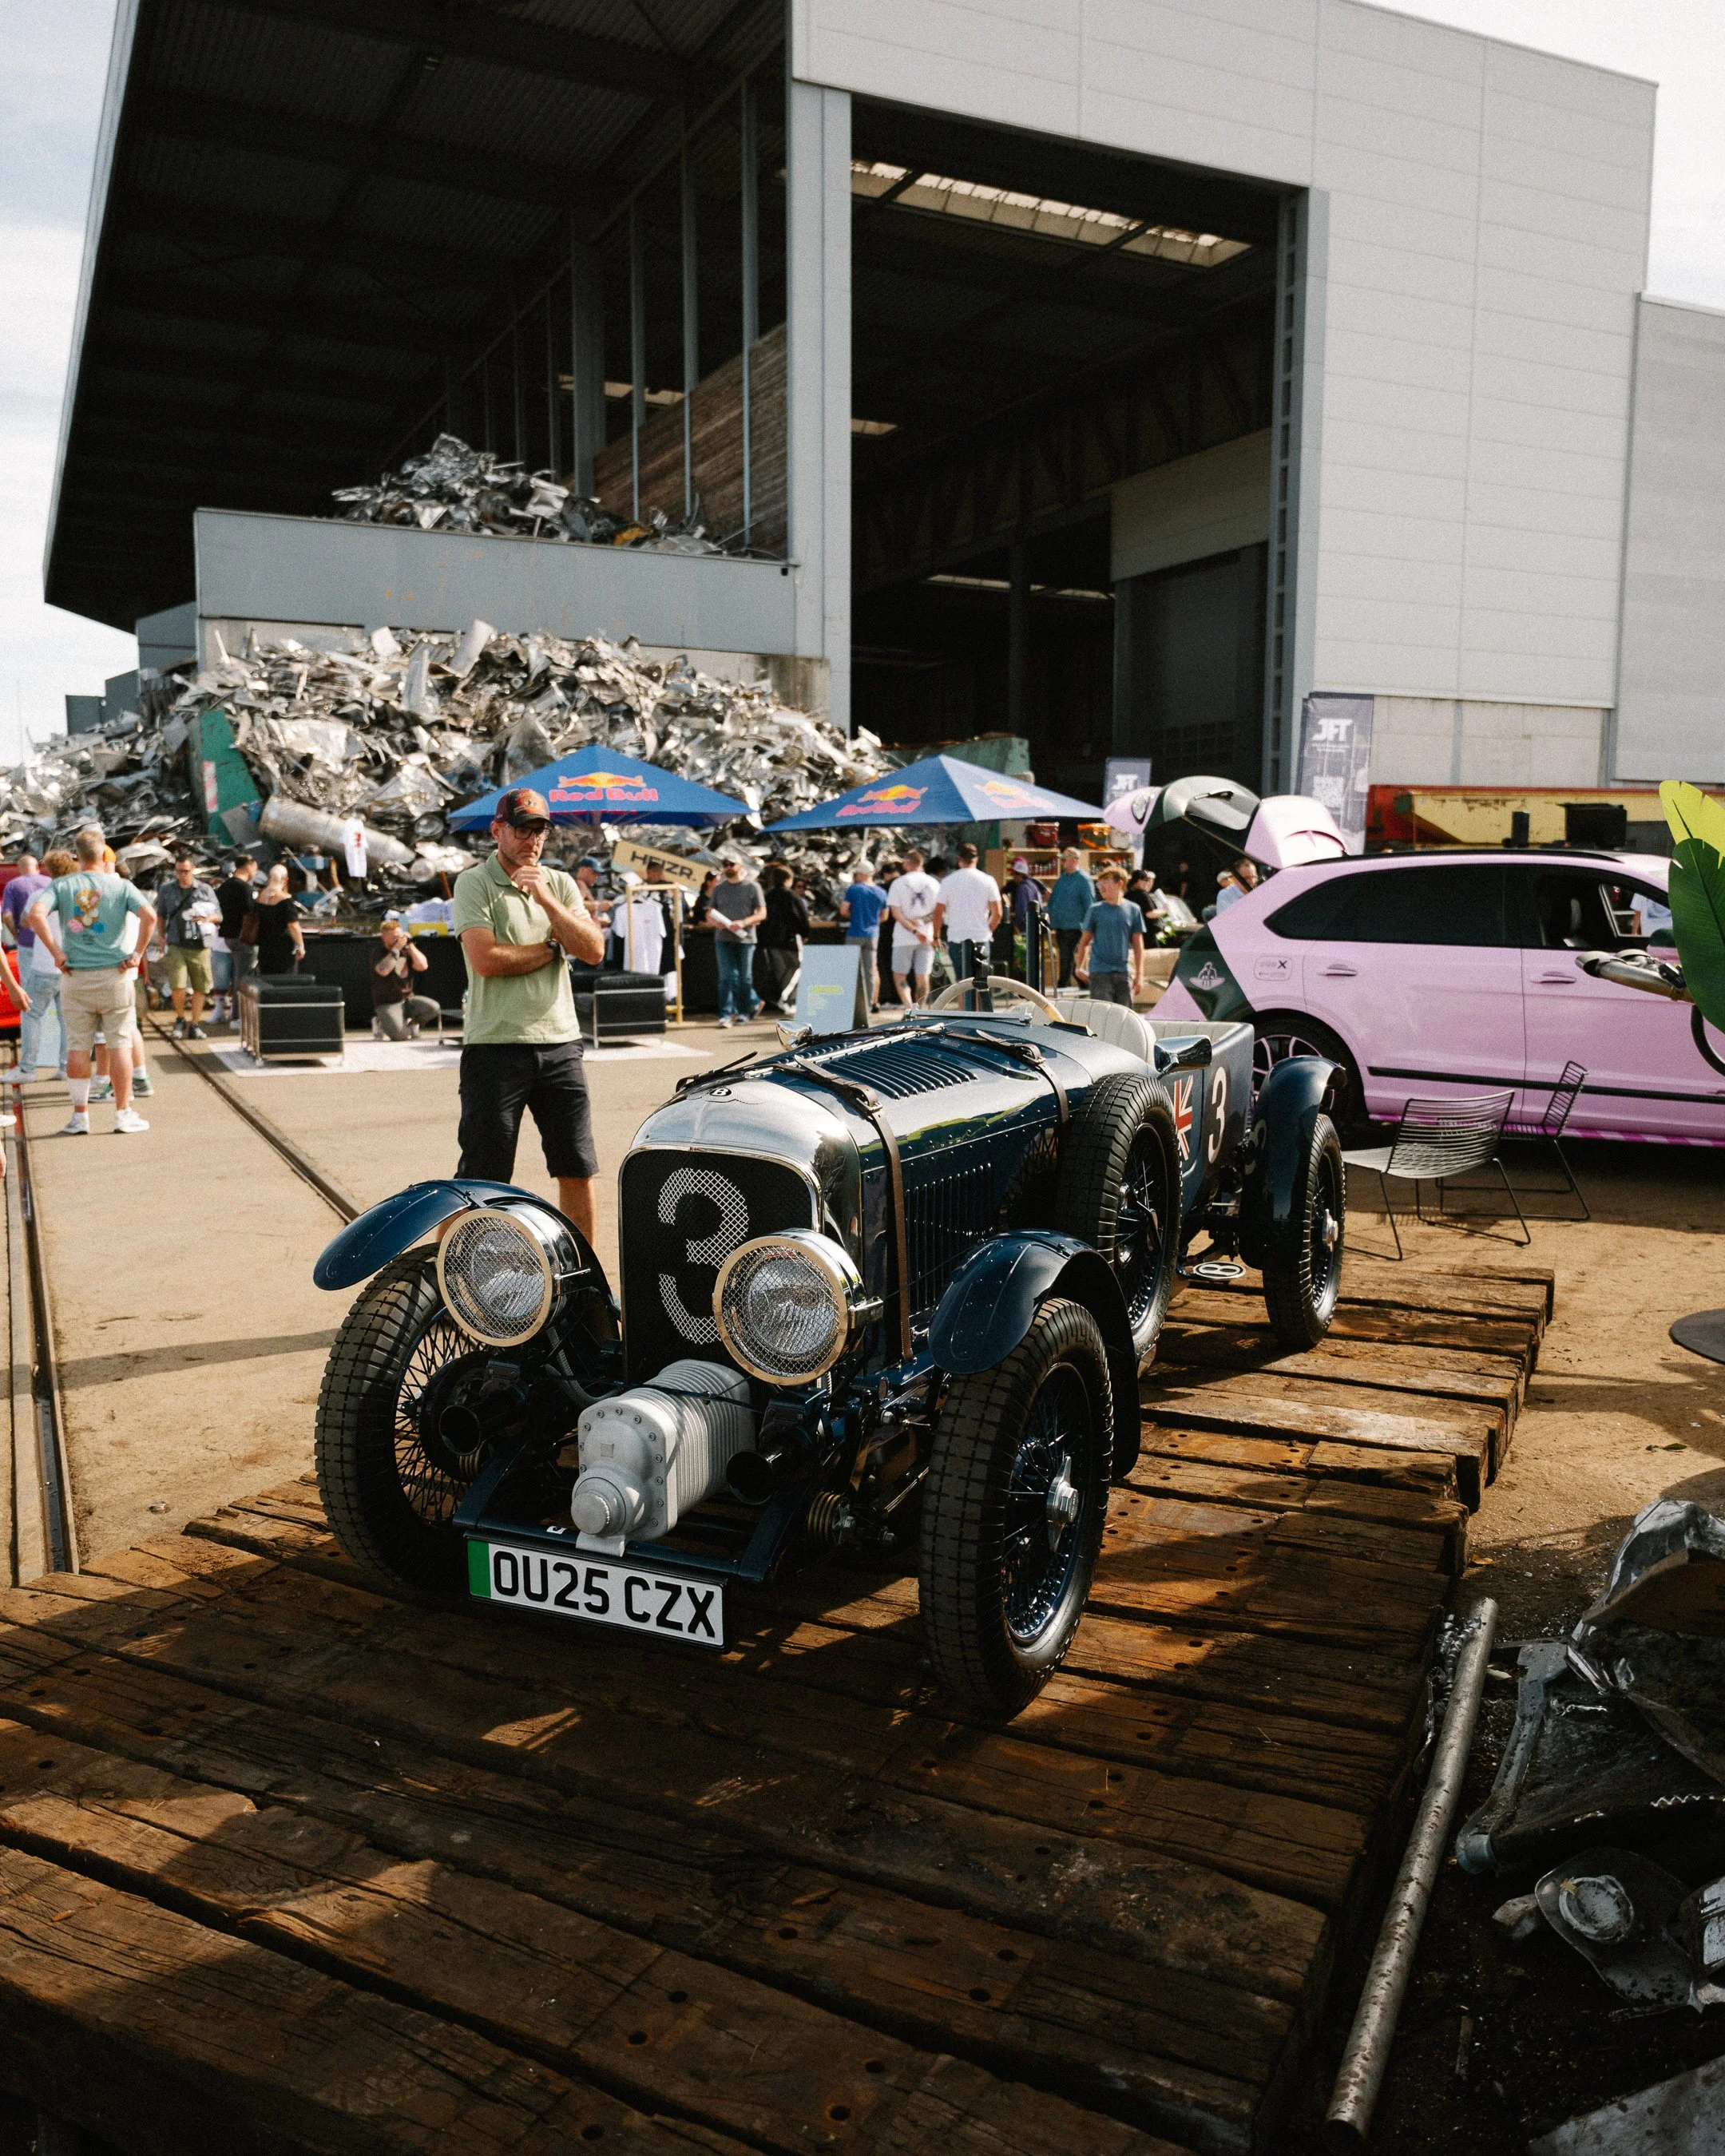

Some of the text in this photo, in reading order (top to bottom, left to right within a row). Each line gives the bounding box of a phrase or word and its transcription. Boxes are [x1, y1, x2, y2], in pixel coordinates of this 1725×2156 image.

[712, 1088, 729, 1096] B
[1208, 1066, 1227, 1164] 3
[658, 1167, 750, 1345] 3
[494, 1551, 716, 1638] OU25 CZX
